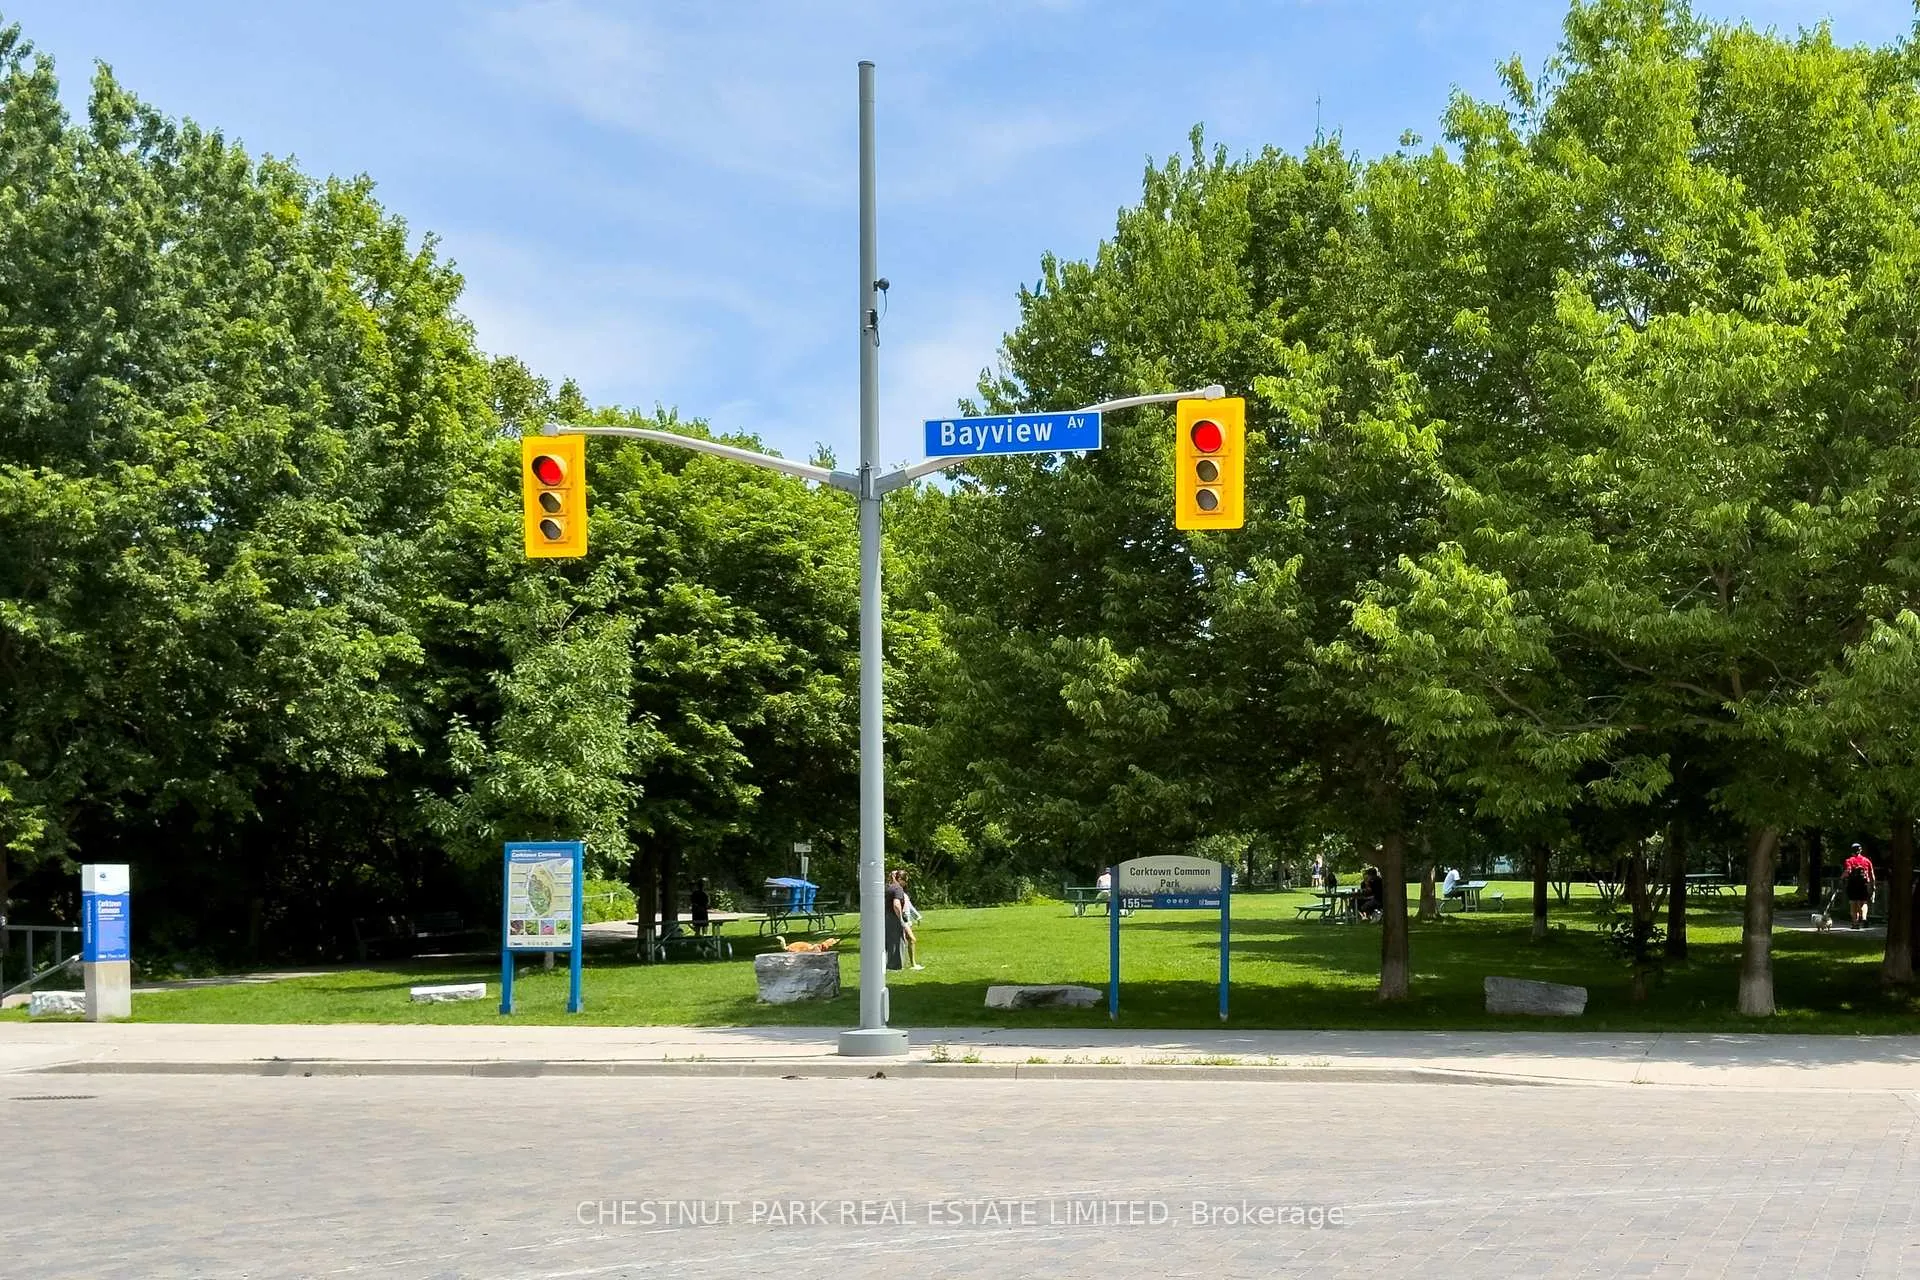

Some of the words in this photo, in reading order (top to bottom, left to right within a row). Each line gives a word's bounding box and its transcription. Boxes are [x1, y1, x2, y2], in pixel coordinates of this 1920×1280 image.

[941, 418, 1053, 450] Bayview
[1067, 416, 1085, 429] Av
[1130, 867, 1171, 876] Corktown
[1174, 867, 1211, 876] Common
[1160, 879, 1180, 888] Park
[1122, 898, 1140, 908] 155
